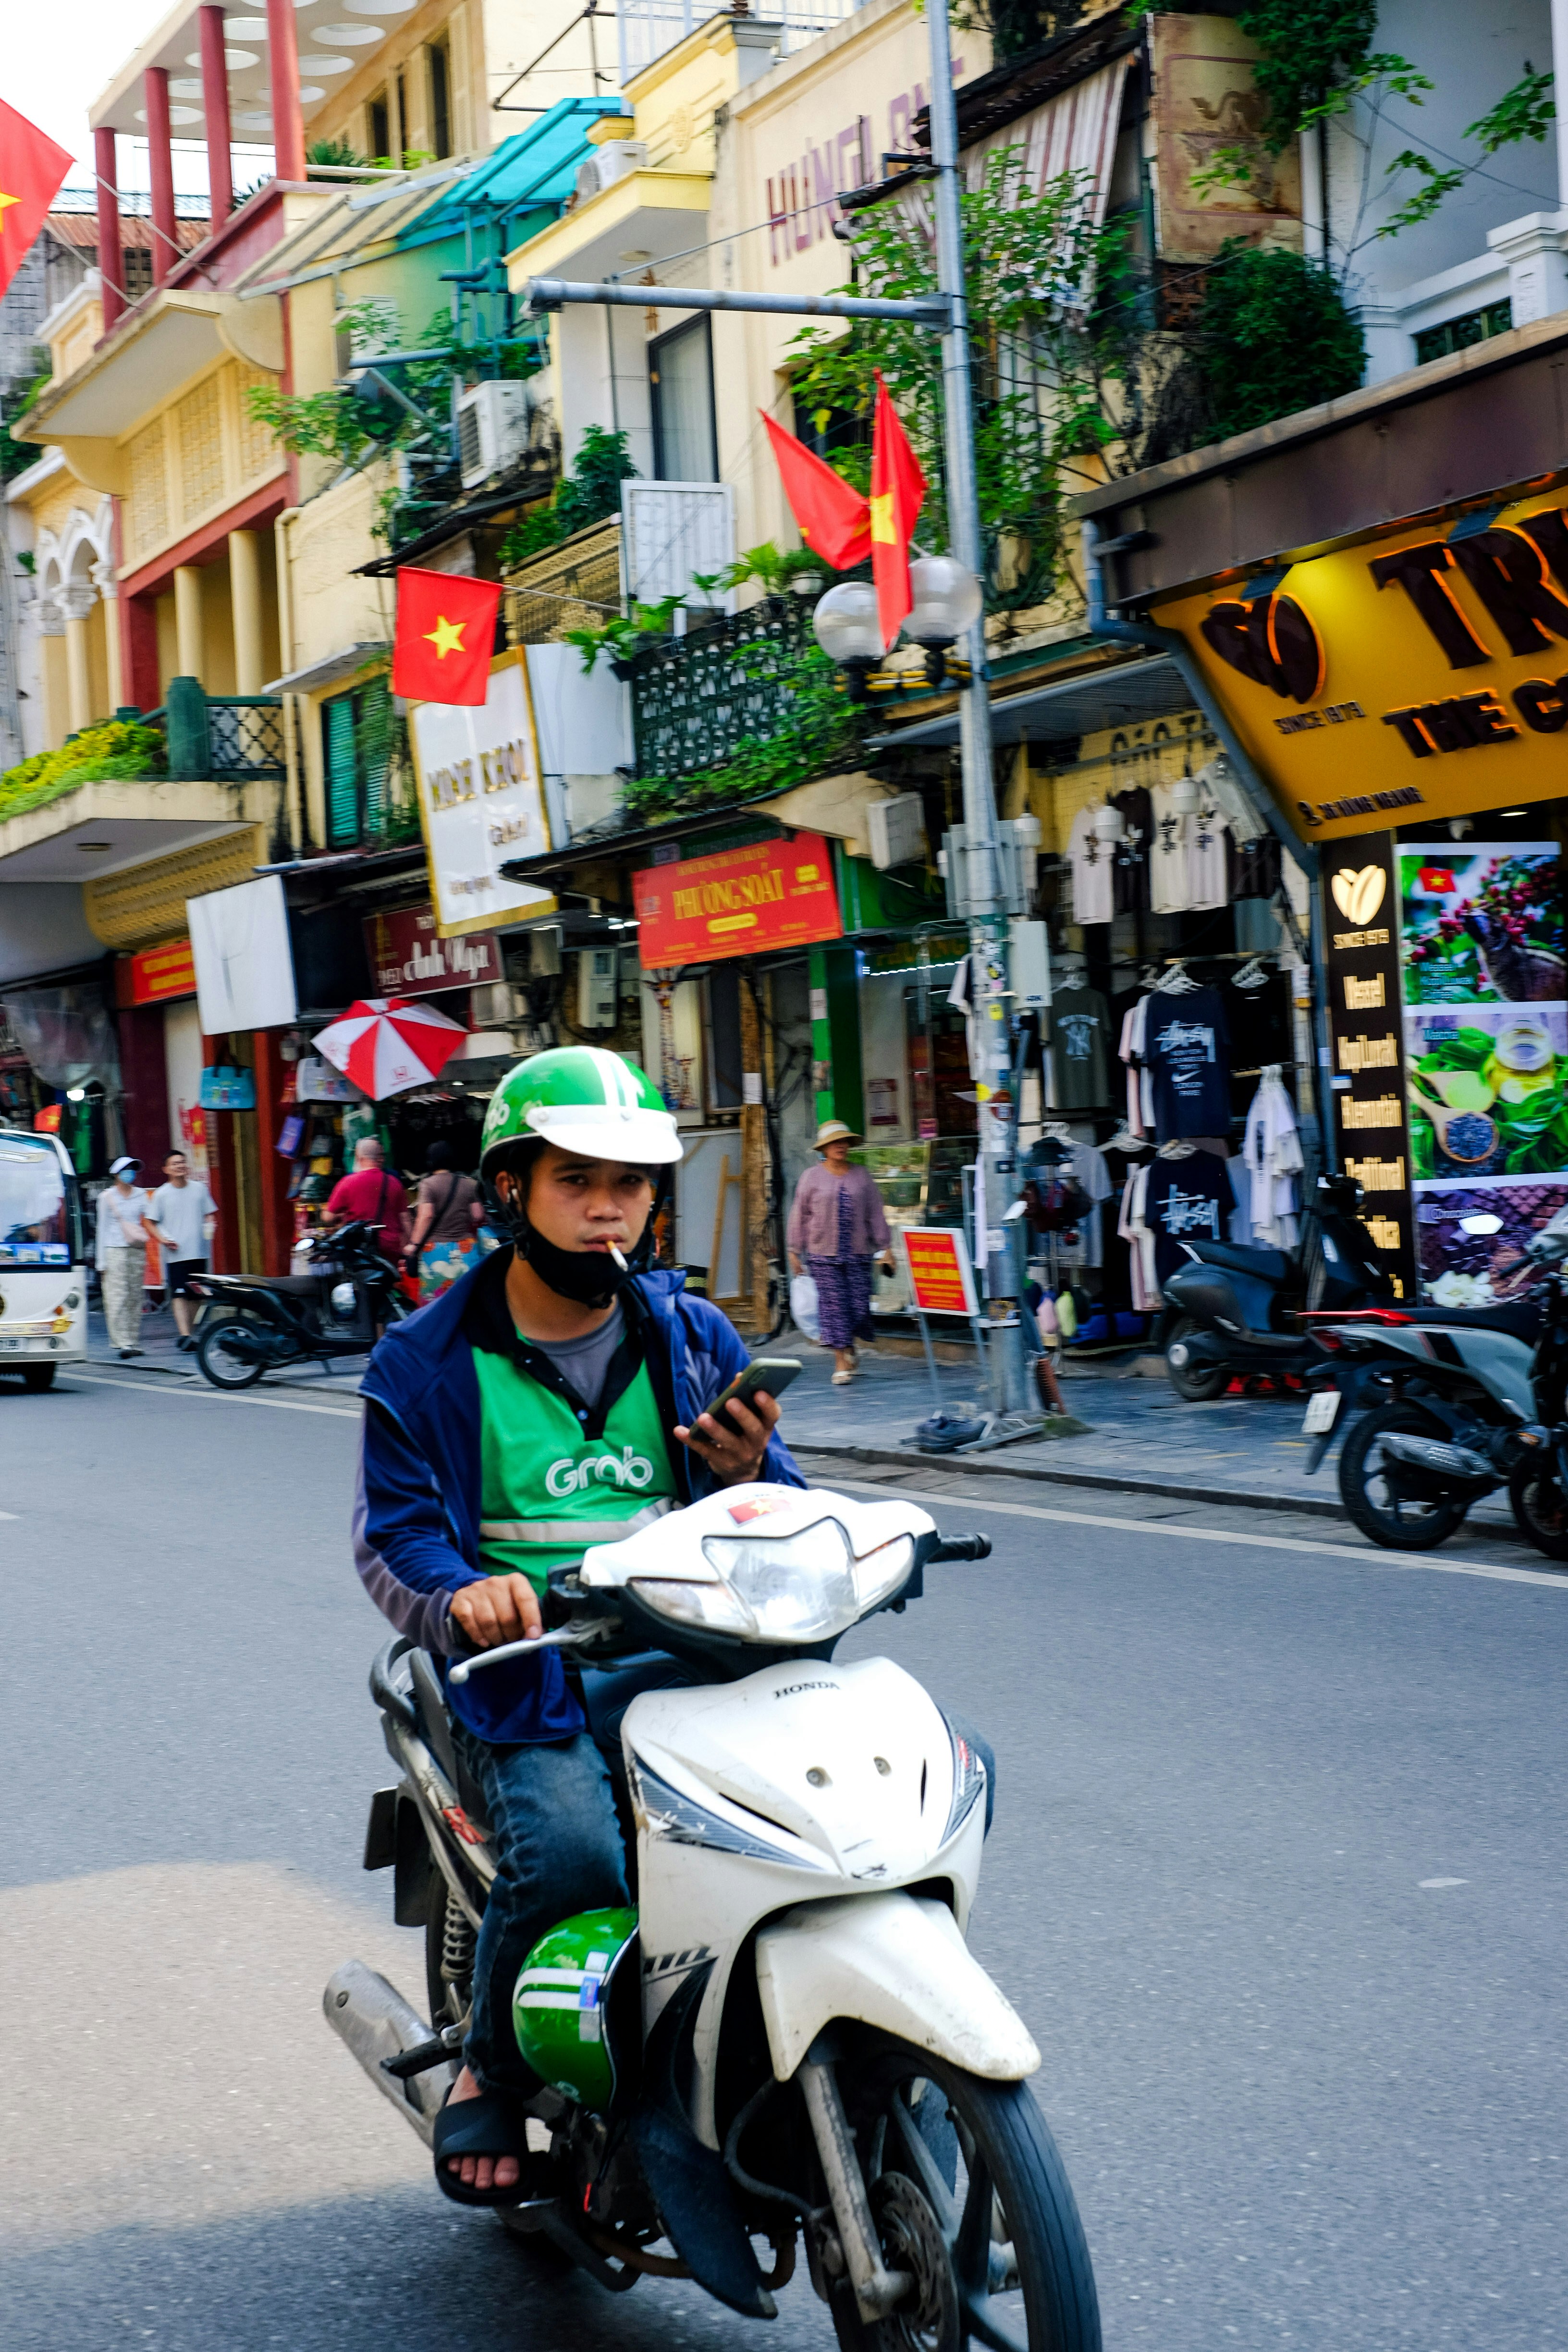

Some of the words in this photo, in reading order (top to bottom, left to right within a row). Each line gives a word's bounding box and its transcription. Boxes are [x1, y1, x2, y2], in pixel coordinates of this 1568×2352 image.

[1380, 688, 1522, 758] THE
[545, 1446, 654, 1497] Grab
[774, 1681, 841, 1700] HONDA
